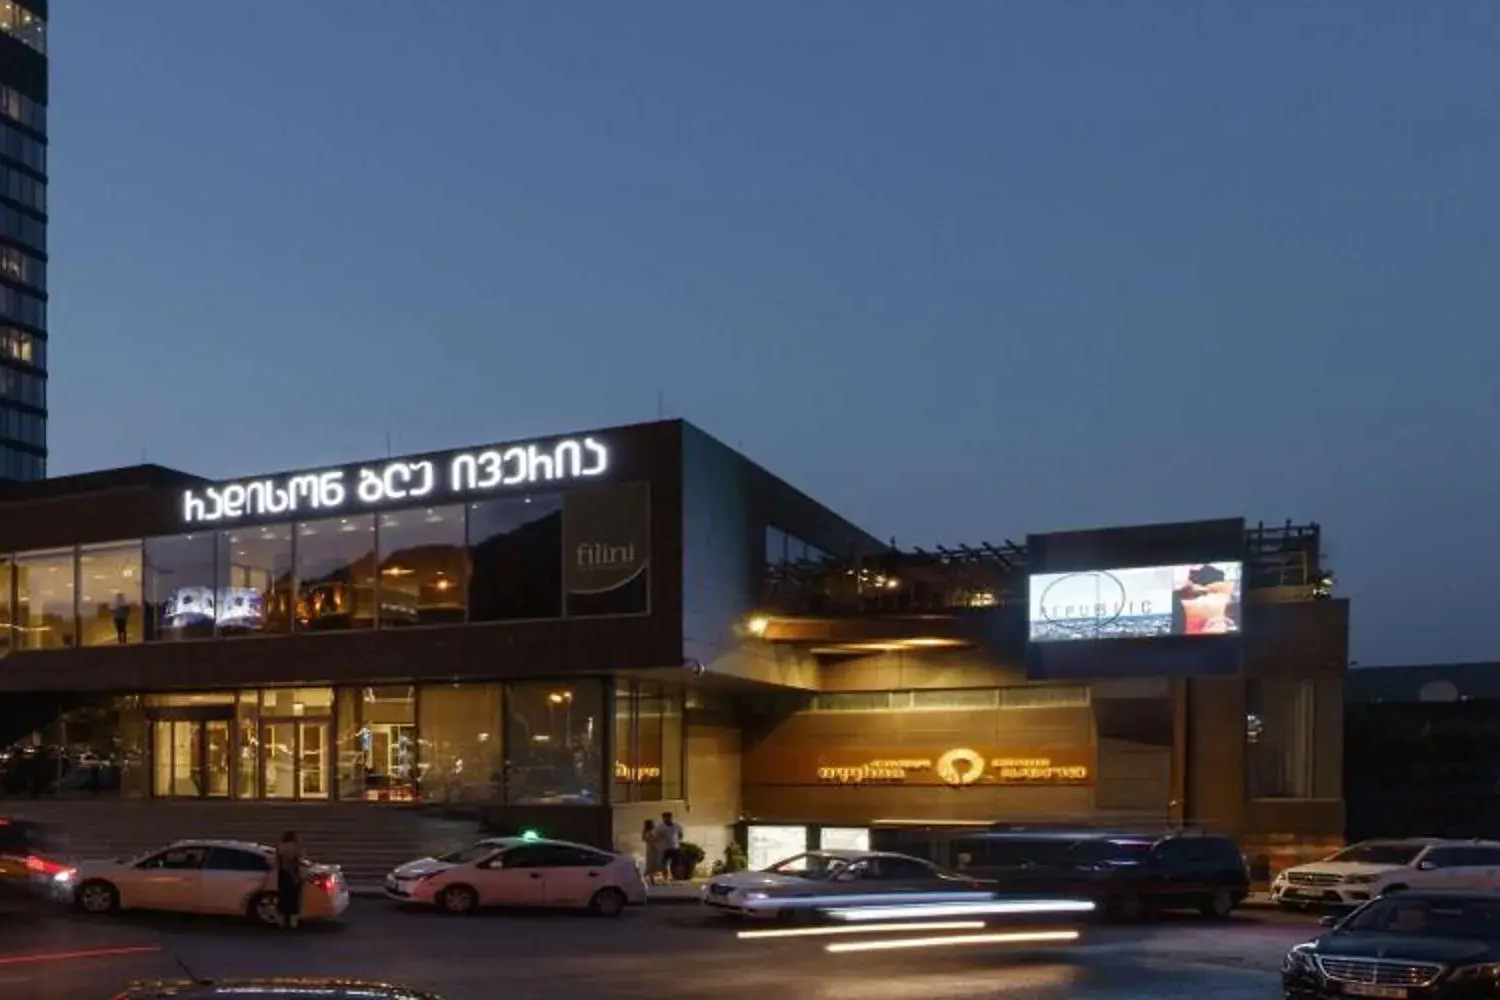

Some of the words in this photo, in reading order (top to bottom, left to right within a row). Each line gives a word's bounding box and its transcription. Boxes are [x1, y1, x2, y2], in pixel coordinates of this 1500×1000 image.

[184, 471, 345, 522] რადისონ
[357, 460, 434, 502] ბლუ
[452, 437, 608, 491] ივერია
